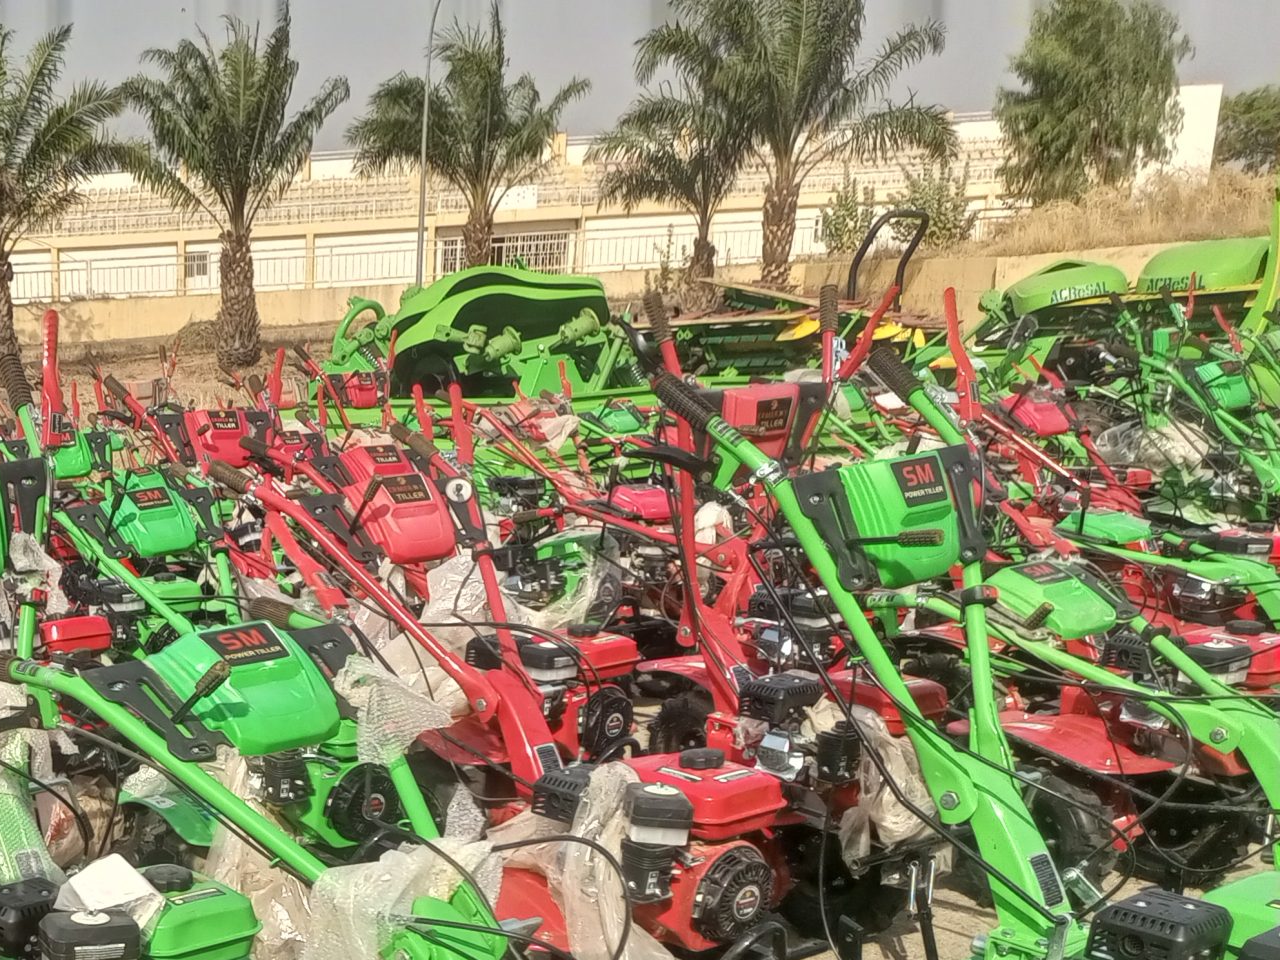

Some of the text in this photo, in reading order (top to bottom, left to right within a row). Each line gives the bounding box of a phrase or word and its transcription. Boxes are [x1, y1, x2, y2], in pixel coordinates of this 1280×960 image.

[902, 463, 935, 487] SM
[135, 490, 162, 500] SM
[396, 491, 426, 500] TILLER
[904, 485, 944, 499] POWER TILLER
[217, 627, 268, 650] SM
[224, 645, 283, 660] POWER TILLER
